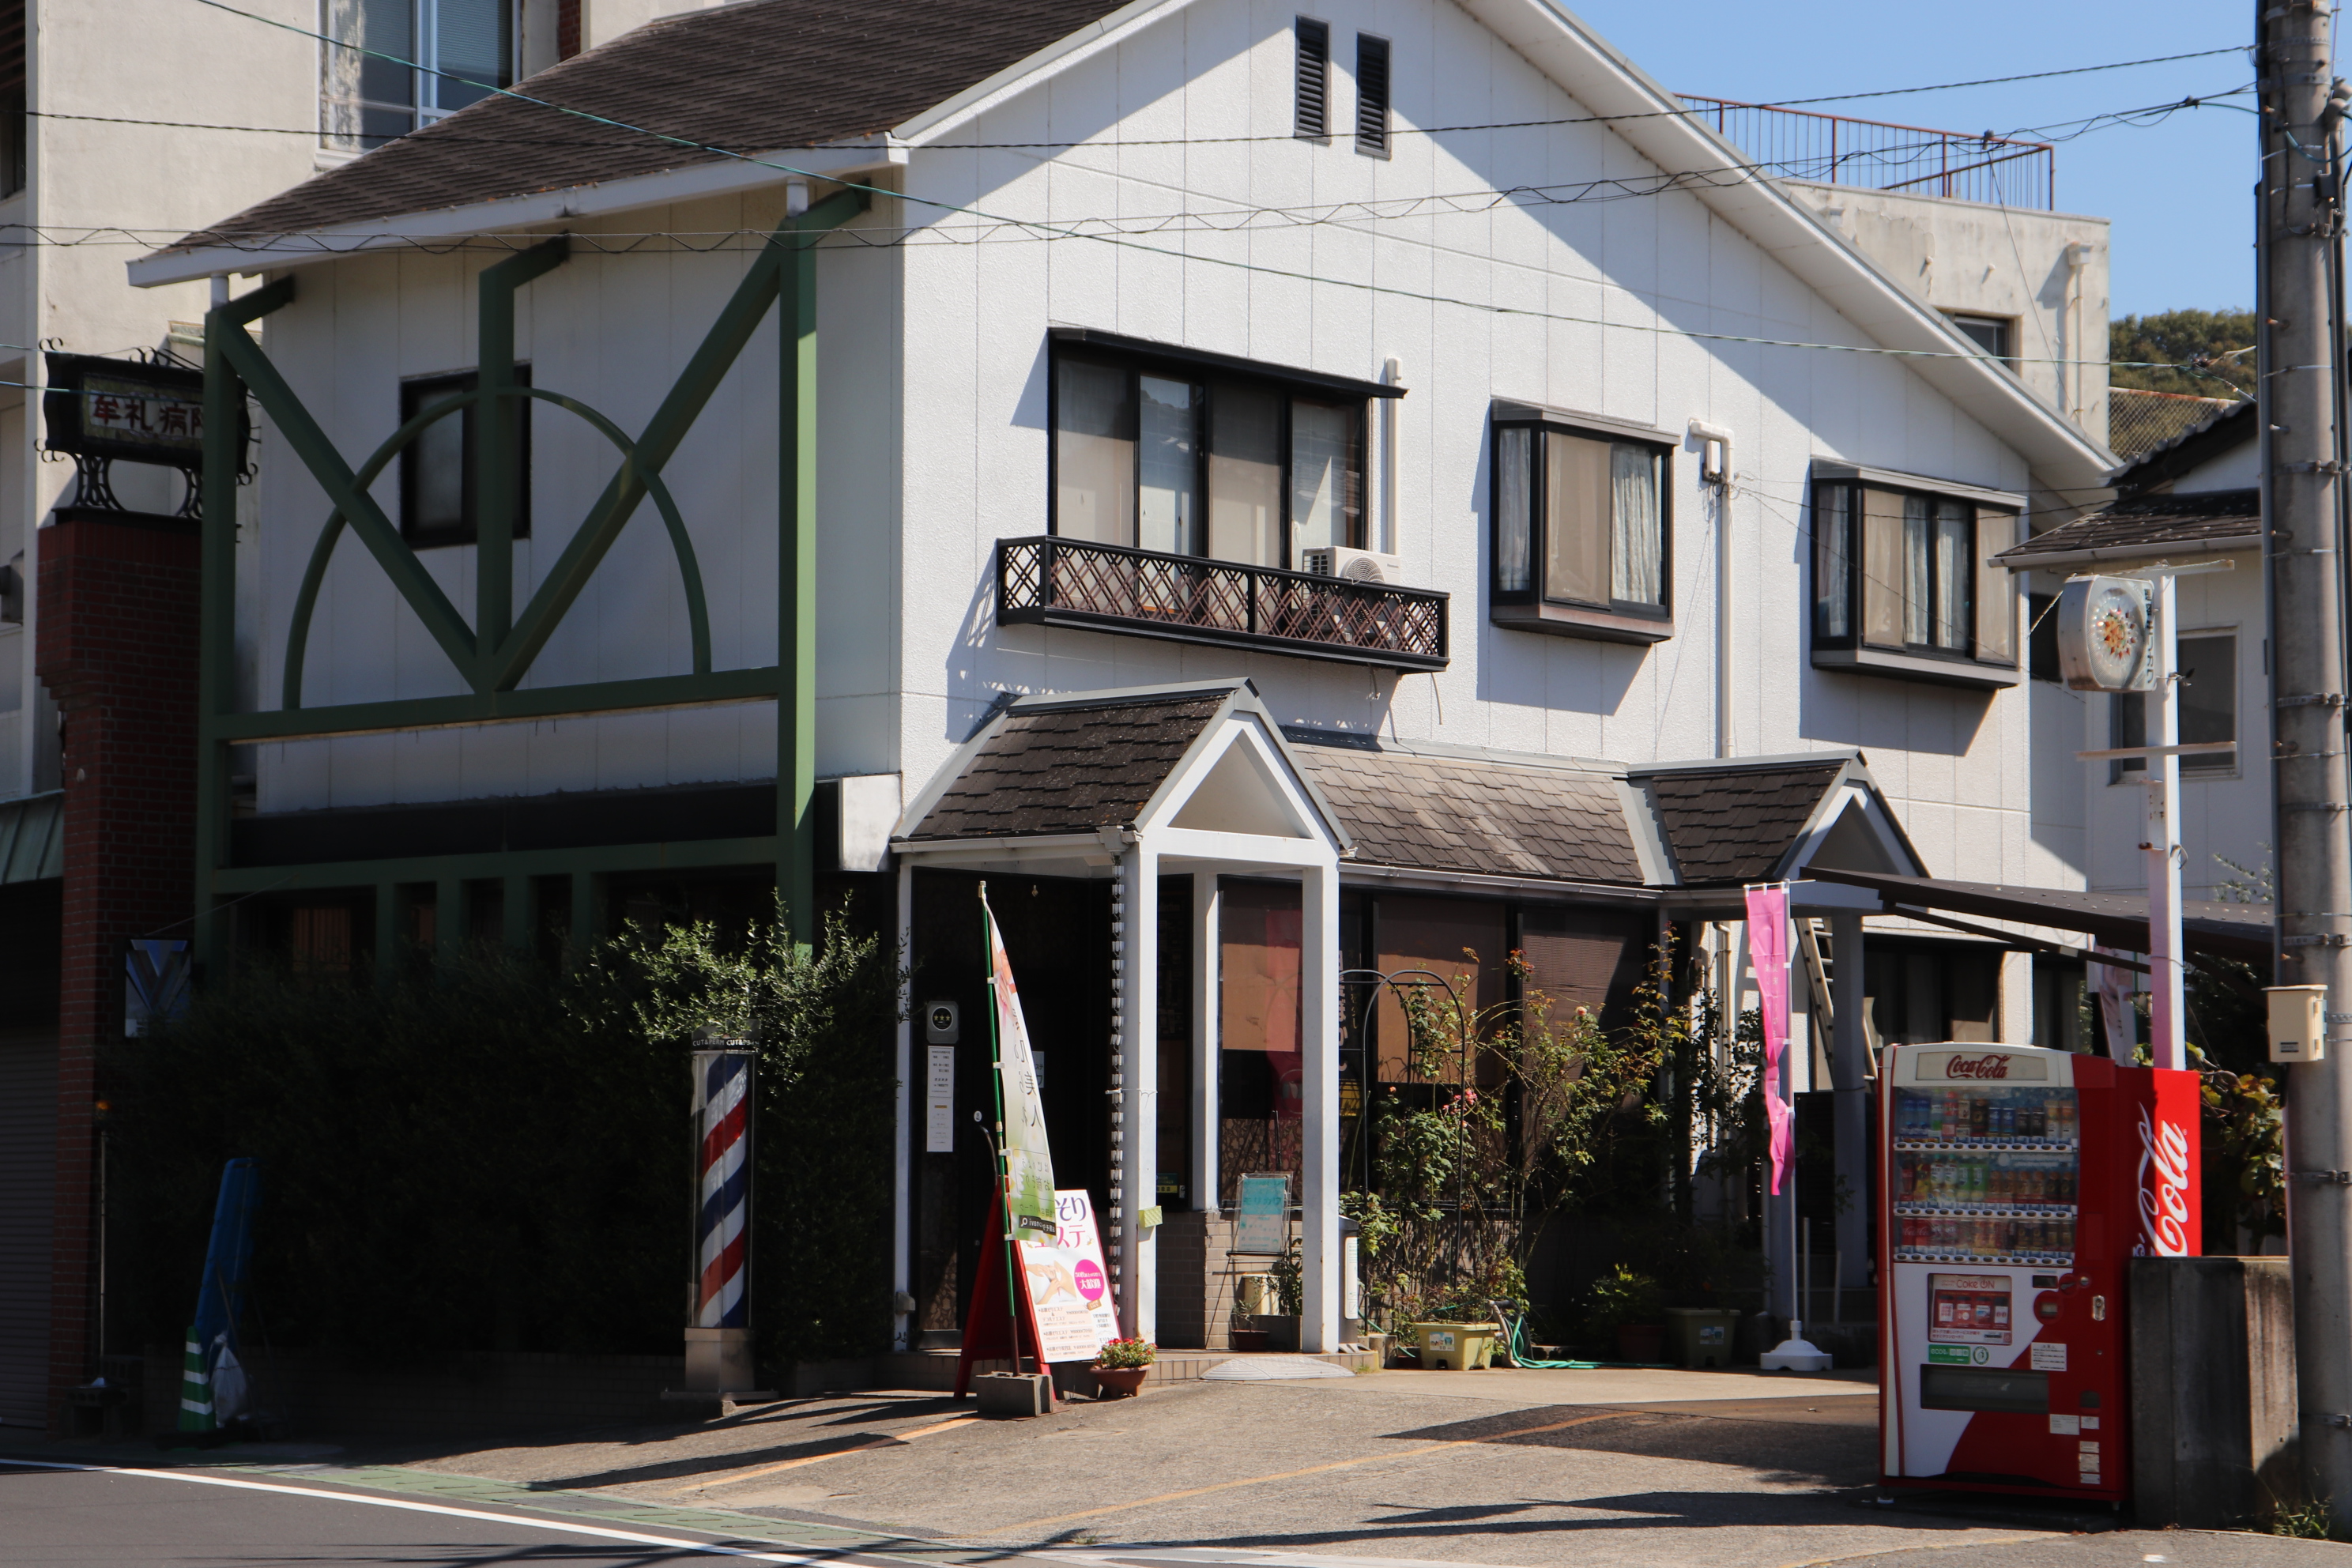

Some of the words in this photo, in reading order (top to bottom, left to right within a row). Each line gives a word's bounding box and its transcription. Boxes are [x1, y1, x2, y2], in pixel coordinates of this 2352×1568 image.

[1947, 1054, 2011, 1079] Coca-Cola
[1080, 1279, 1102, 1290] 大歓迎
[1956, 1280, 1979, 1288] Coke
